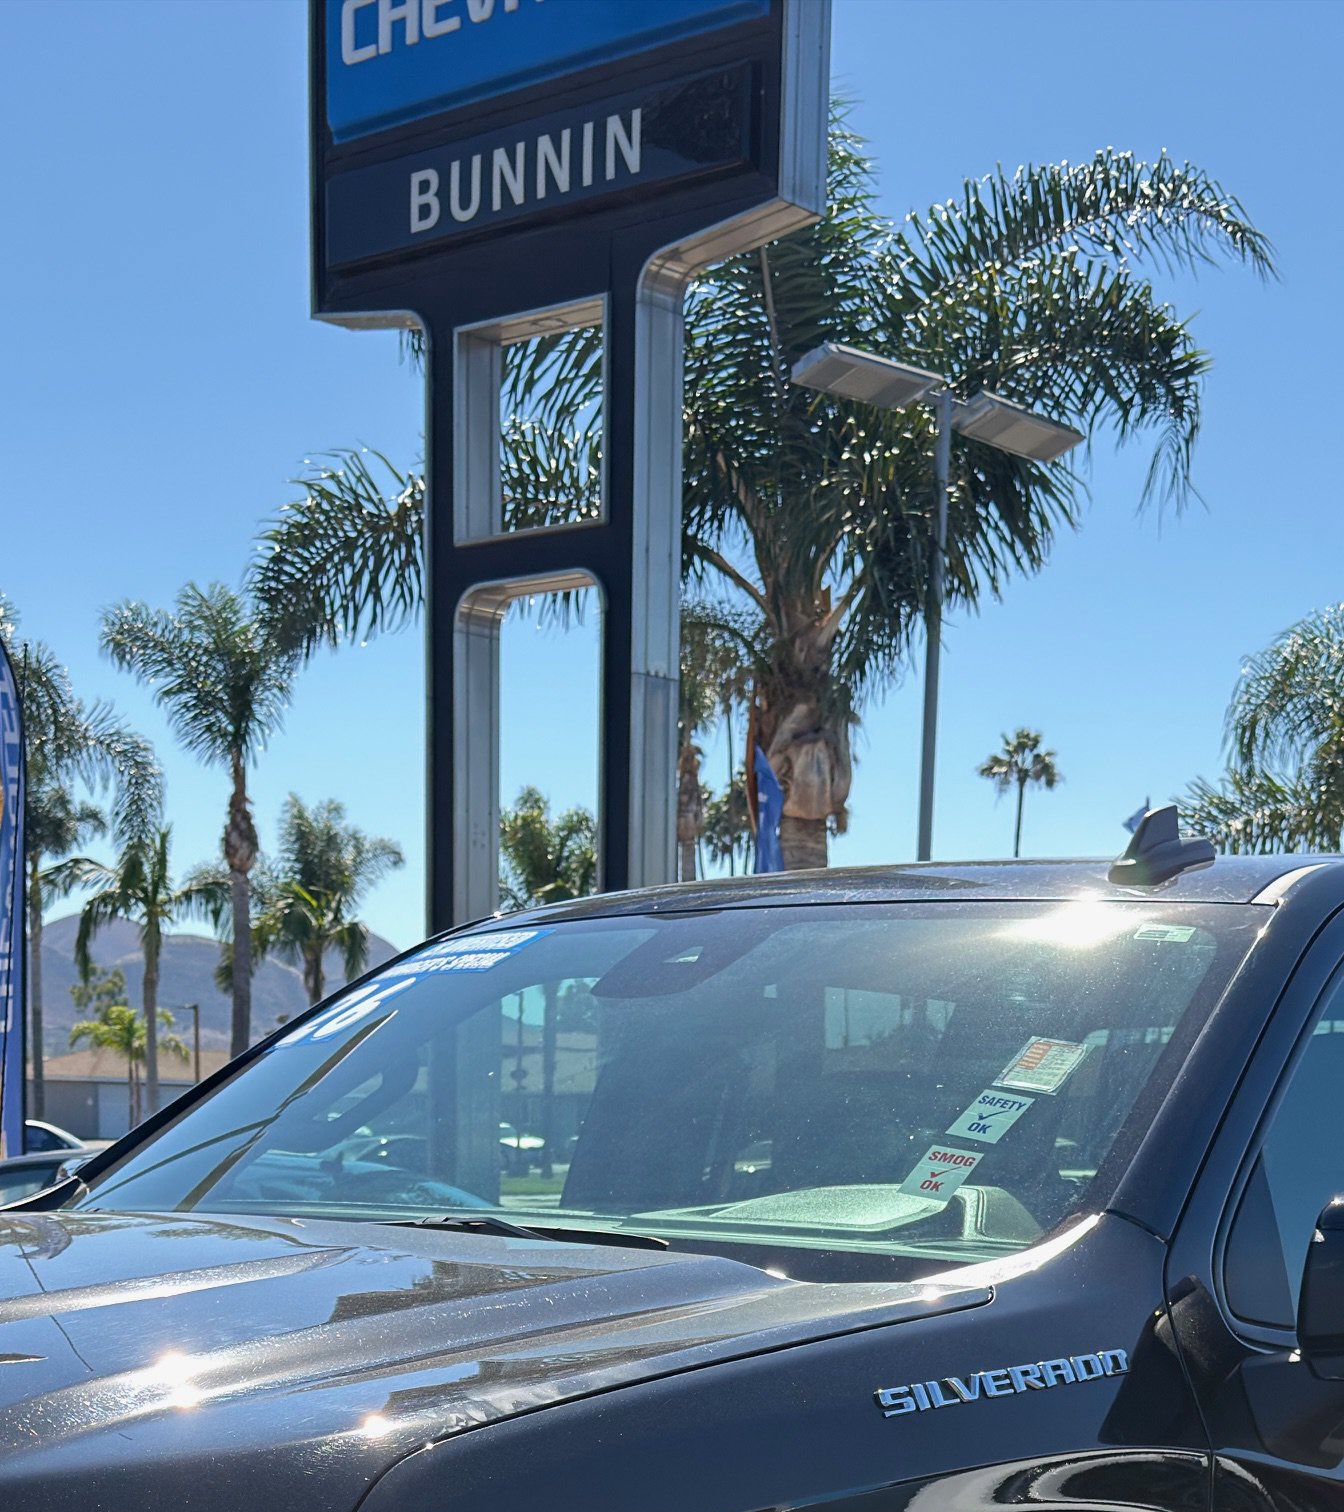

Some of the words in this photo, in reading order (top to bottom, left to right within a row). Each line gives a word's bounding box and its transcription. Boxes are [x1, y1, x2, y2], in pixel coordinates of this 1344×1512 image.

[409, 108, 643, 235] BUNNIN
[977, 1094, 1027, 1112] SAFETY
[967, 1121, 993, 1135] OK
[928, 1150, 977, 1167] SMOG
[919, 1179, 945, 1192] OK
[873, 1348, 1131, 1418] SILVERADO
